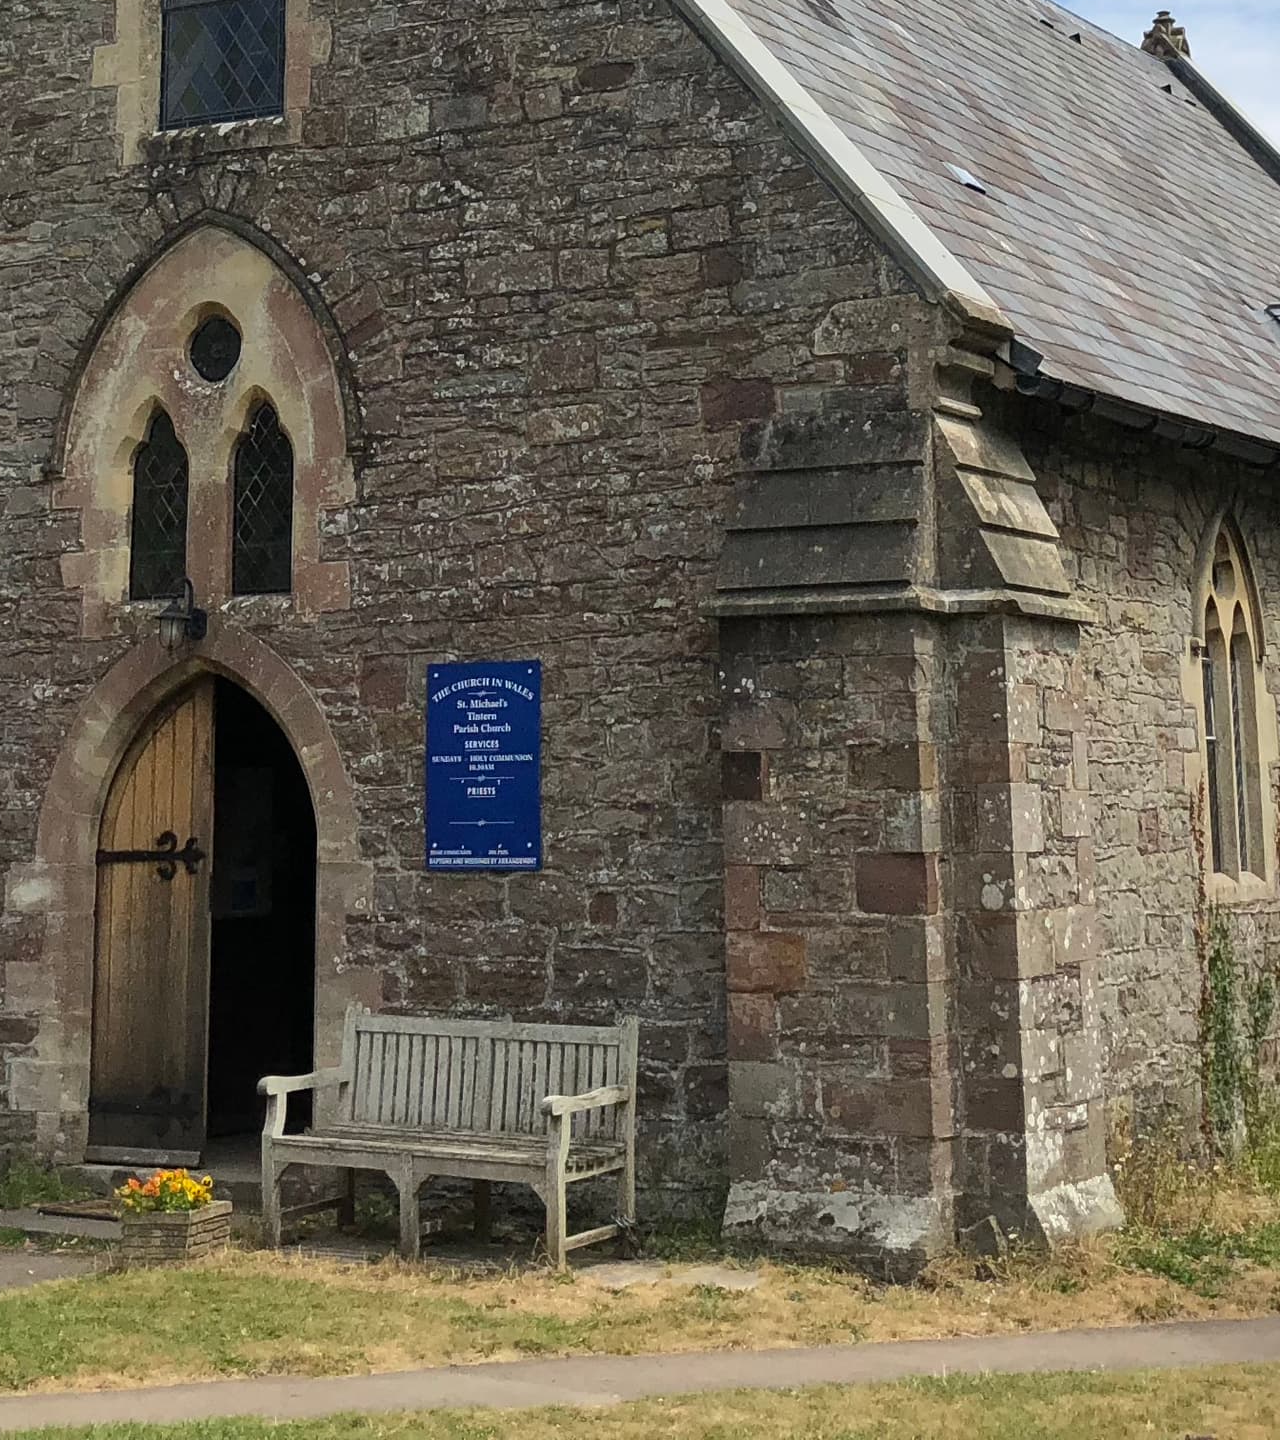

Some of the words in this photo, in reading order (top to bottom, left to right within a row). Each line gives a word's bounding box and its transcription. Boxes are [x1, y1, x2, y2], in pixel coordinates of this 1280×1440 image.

[432, 687, 451, 703] THE
[451, 678, 489, 692] CHURCH
[491, 677, 503, 688] IN
[505, 679, 535, 701] WALES
[457, 699, 468, 709] St.
[470, 698, 508, 709] Michael's
[467, 711, 497, 721] Tintern
[453, 724, 478, 734] Parish
[480, 722, 511, 733] Church
[464, 740, 499, 749] SERVICES
[467, 787, 496, 795] PRIESTS
